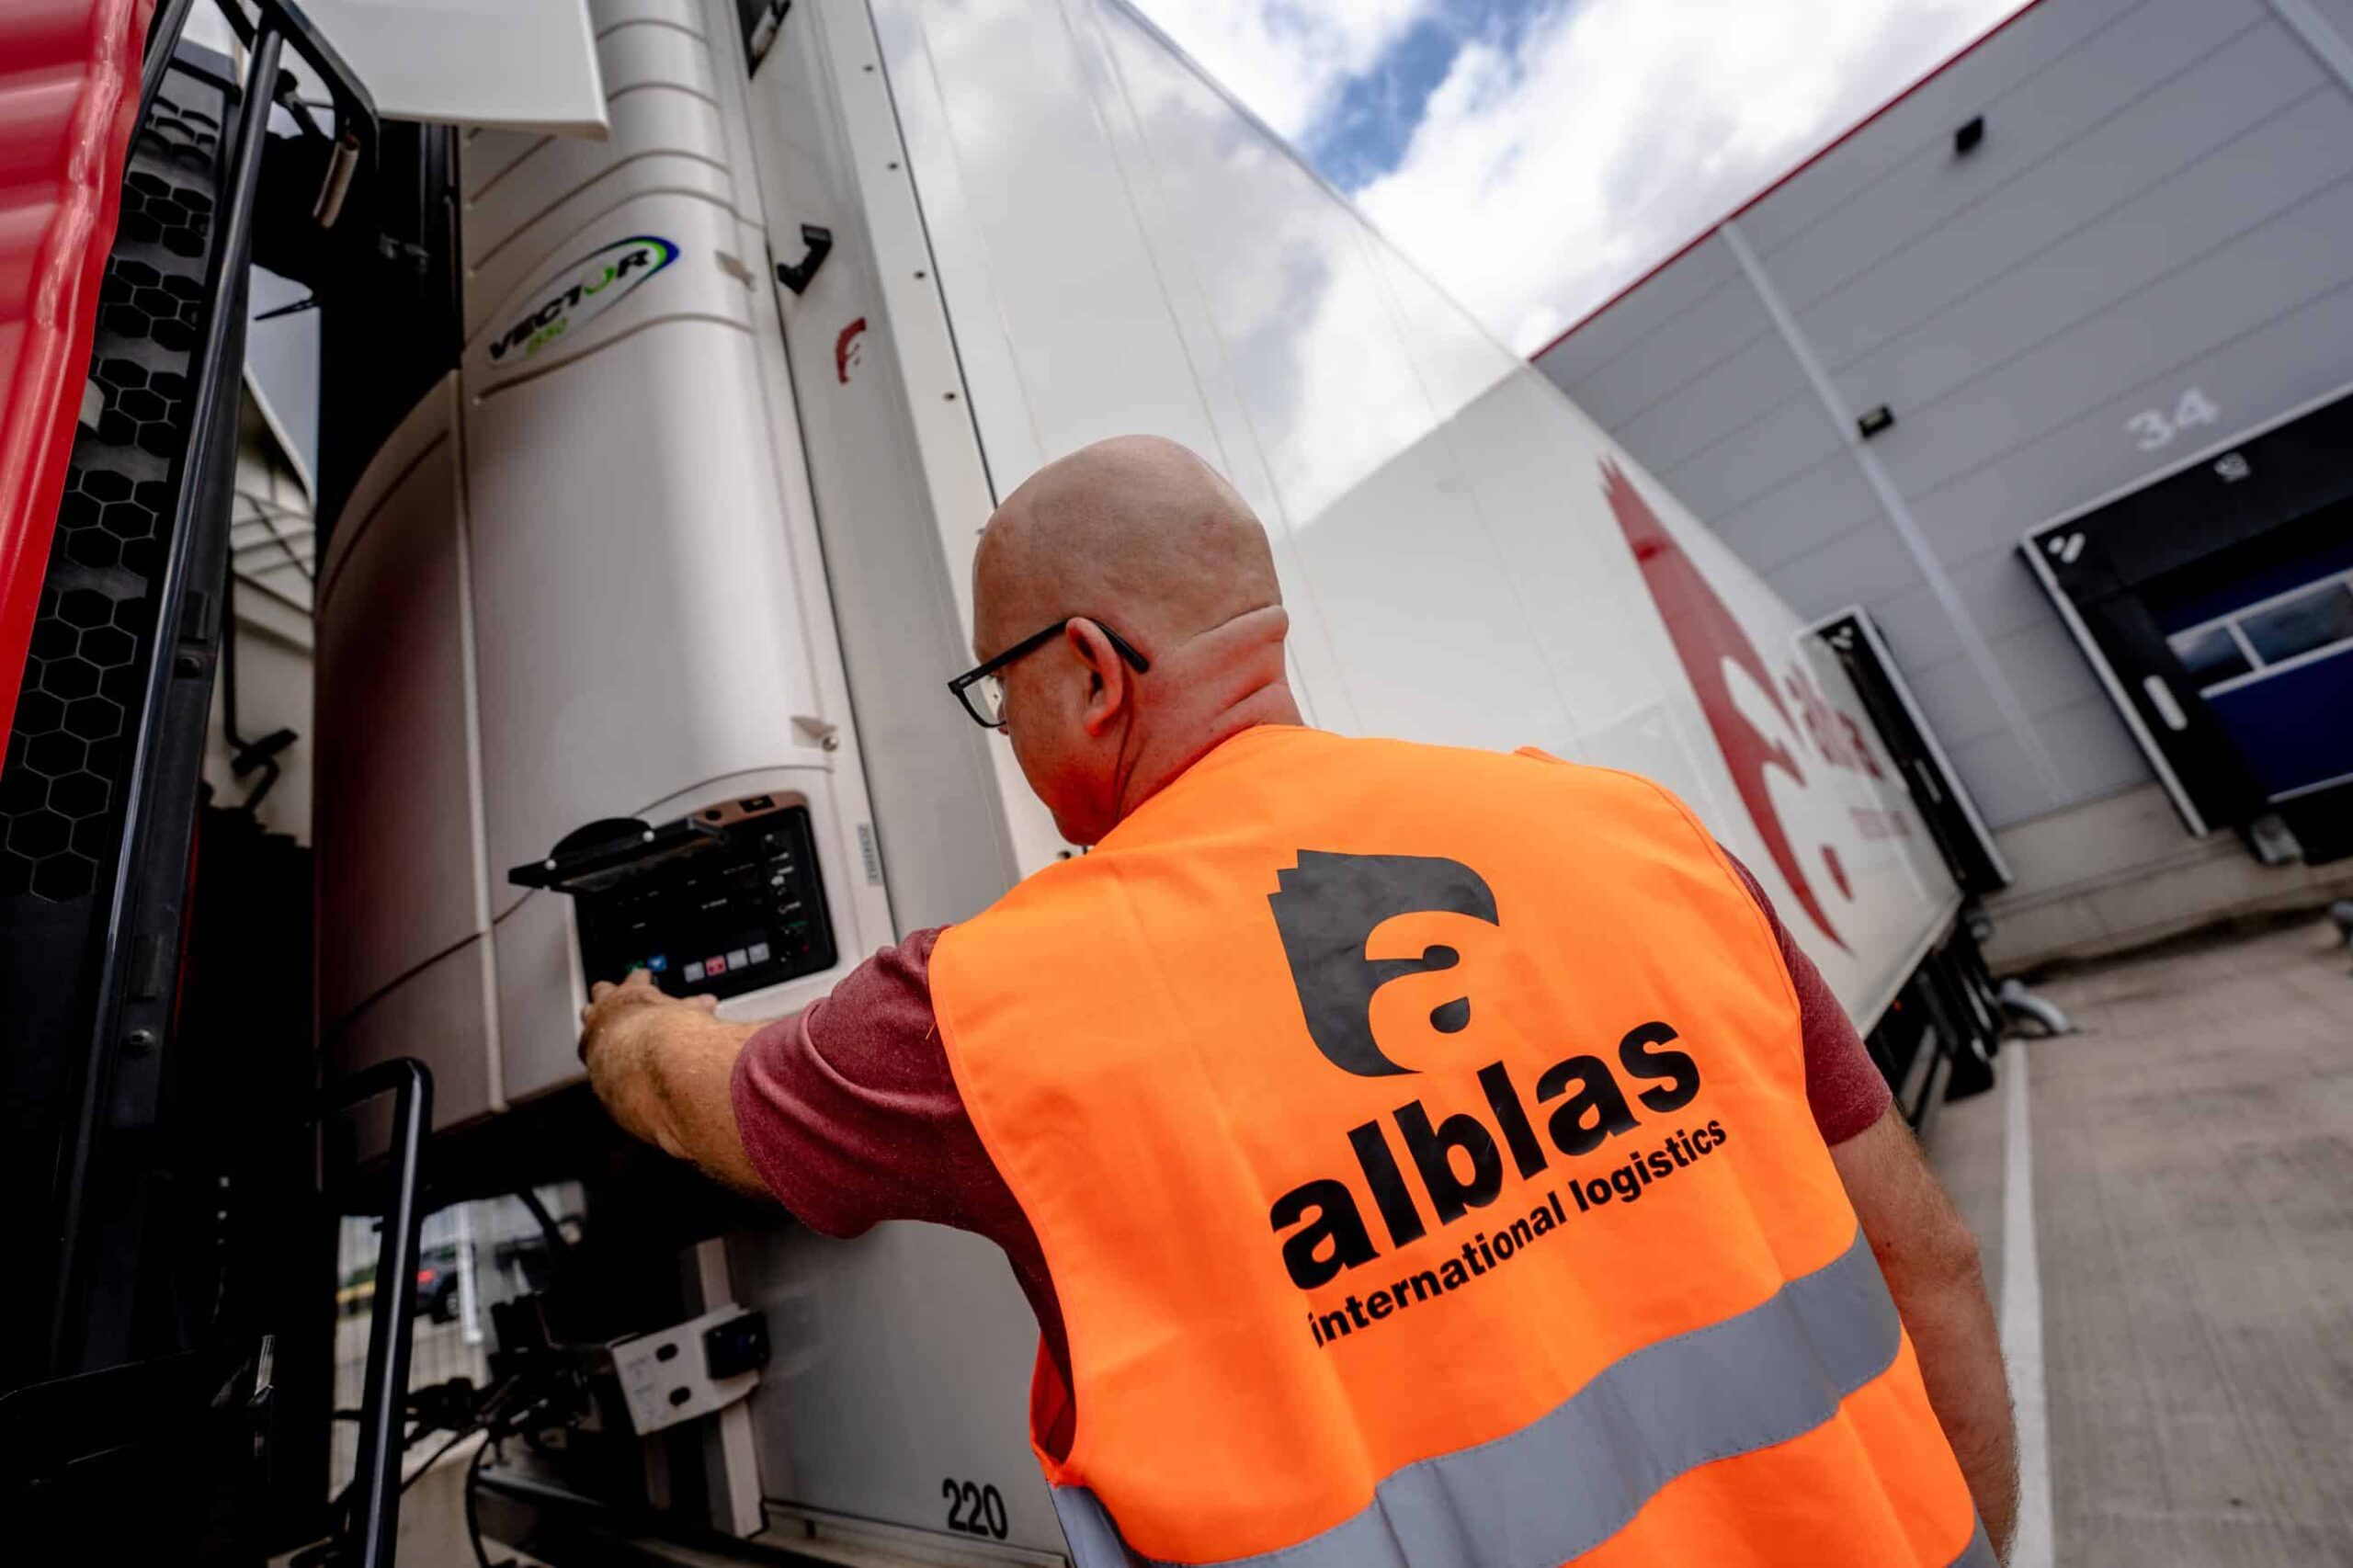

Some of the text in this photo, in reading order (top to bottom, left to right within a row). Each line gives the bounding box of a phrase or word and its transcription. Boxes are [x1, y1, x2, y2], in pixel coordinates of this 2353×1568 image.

[2126, 385, 2219, 450] 34
[1269, 1020, 1701, 1290] alblas
[1306, 1119, 1727, 1349] international logistics
[942, 1477, 1007, 1540] 220
